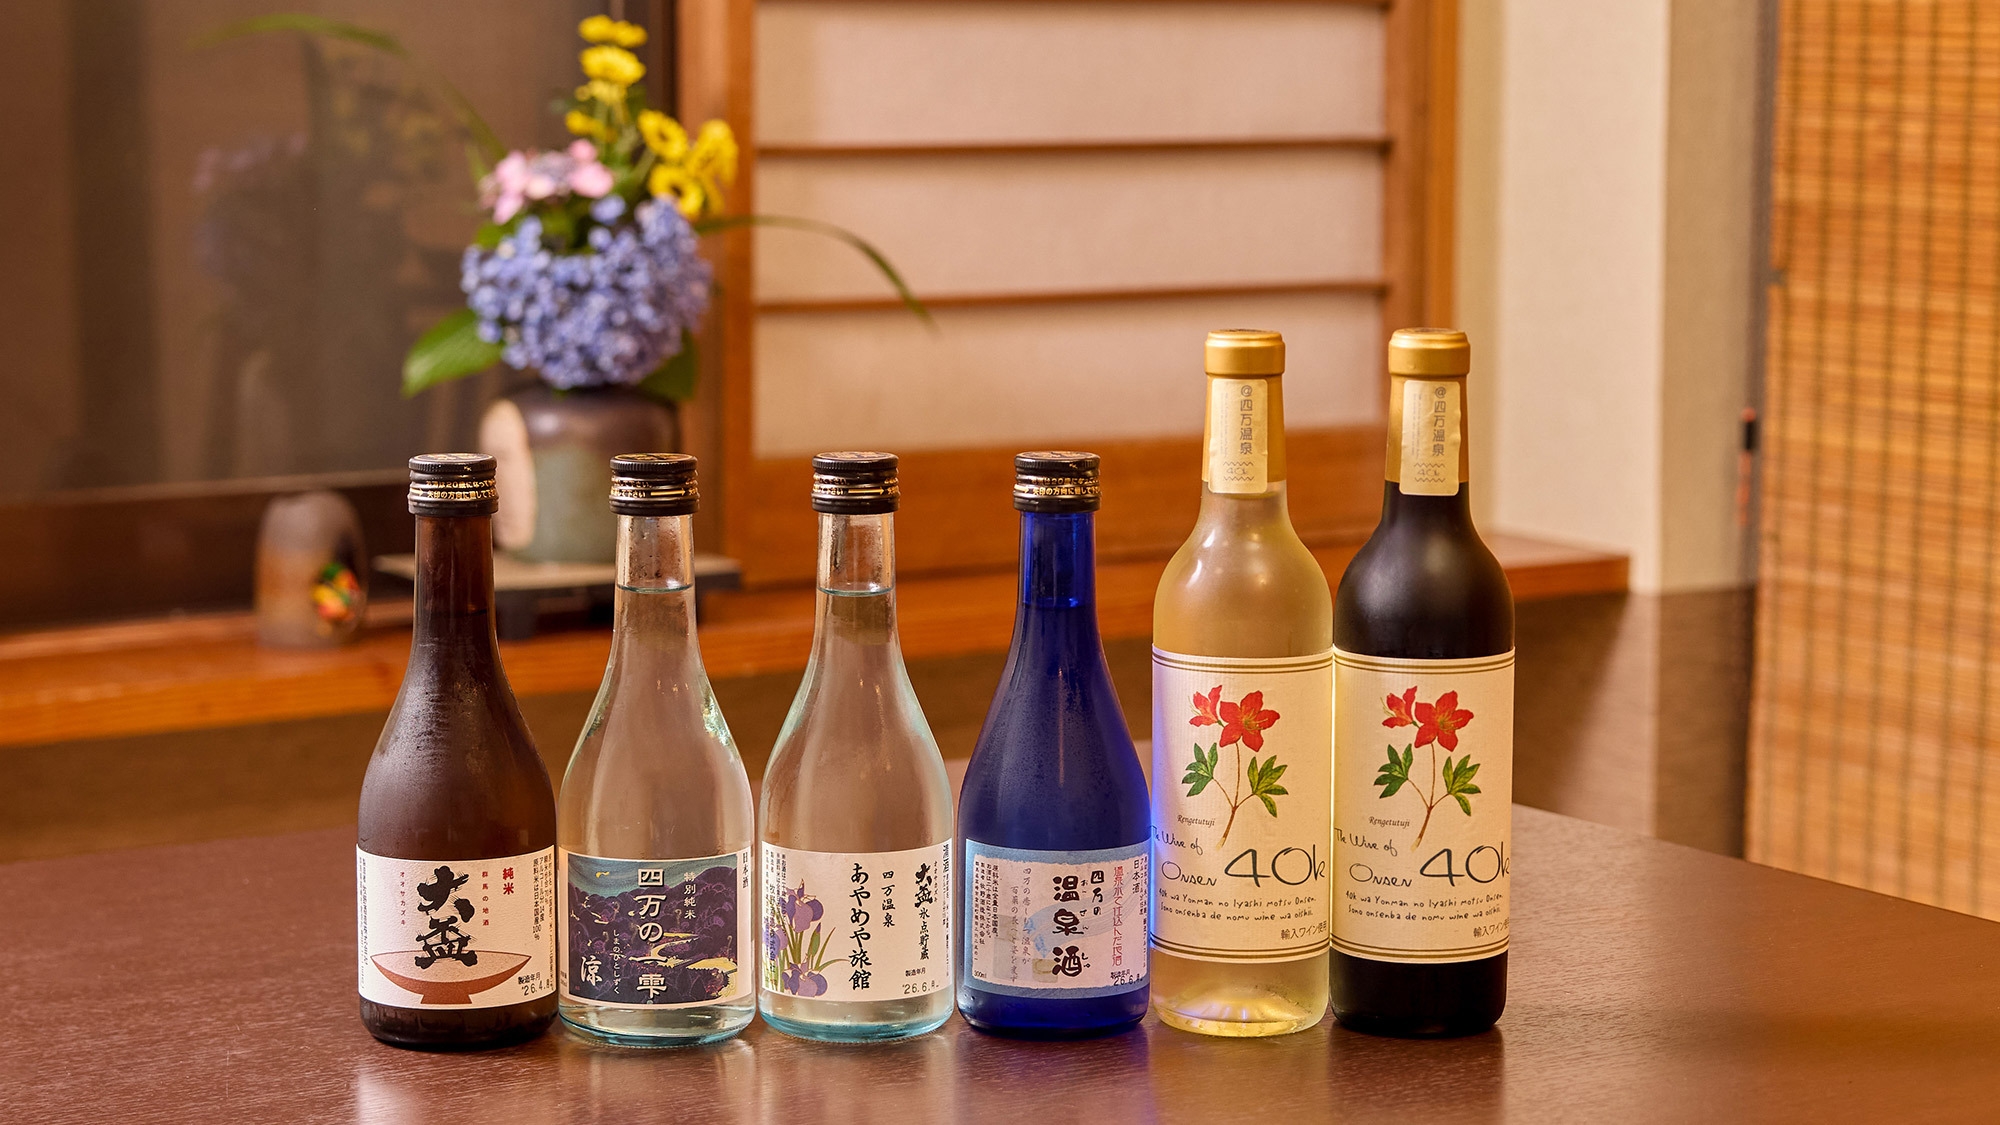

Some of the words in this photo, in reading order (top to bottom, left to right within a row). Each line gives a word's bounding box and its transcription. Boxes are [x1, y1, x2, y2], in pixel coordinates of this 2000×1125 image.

[1240, 384, 1253, 455] @四万温泉
[1432, 386, 1446, 457] @四万温泉
[1162, 831, 1186, 848] Wine
[1190, 837, 1203, 855] of
[1177, 815, 1216, 828] Rengetutuji
[1368, 816, 1410, 829] Rengetutuji
[1161, 861, 1217, 886] Onsen
[1224, 844, 1326, 888] 40k
[1349, 833, 1379, 850] Wine
[1383, 839, 1398, 857] of
[1349, 863, 1413, 887] Onsen
[1420, 841, 1510, 887] 40k
[503, 867, 515, 896] 純米
[683, 872, 697, 920] 特別純米
[1091, 870, 1105, 915] 四万の
[1132, 859, 1141, 894] 日本酒
[415, 866, 478, 970] 大盃
[881, 870, 896, 928] 四万温泉
[1175, 909, 1207, 918] onsenba
[1210, 911, 1222, 920] de
[1254, 911, 1276, 921] wine
[1280, 912, 1292, 920] wa
[1182, 894, 1213, 906] Yonman
[1266, 899, 1292, 907] motsu
[1366, 911, 1401, 920] onsenba
[1405, 911, 1417, 921] de
[1449, 910, 1469, 920] wine
[1374, 895, 1409, 907] Yonman
[1460, 897, 1484, 906] motsu
[635, 868, 667, 999] 四万の一雫
[848, 862, 874, 990] あやめや旅館
[1052, 875, 1085, 977] 温泉酒
